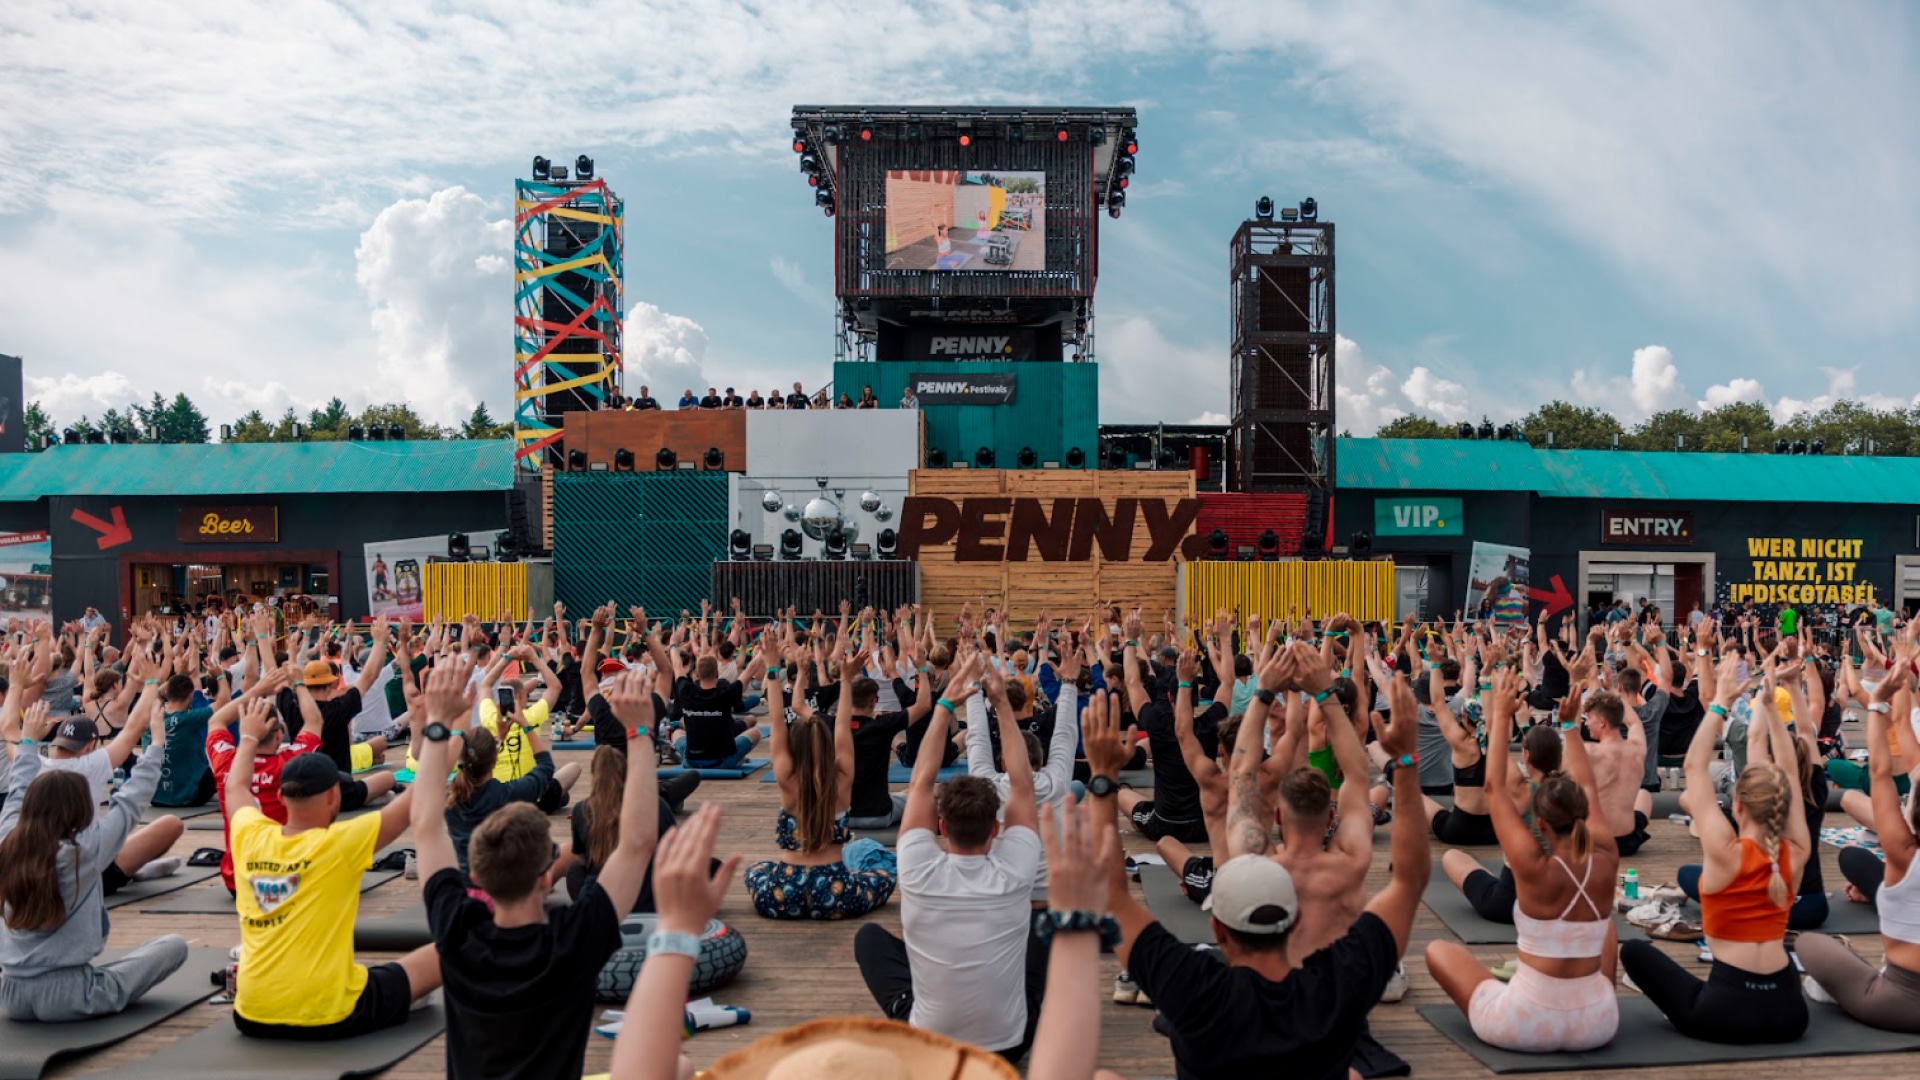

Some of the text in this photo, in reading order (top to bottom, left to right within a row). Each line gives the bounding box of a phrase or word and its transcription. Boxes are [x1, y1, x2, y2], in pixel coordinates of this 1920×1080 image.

[930, 336, 1012, 354] PENNY.
[917, 382, 1007, 394] PENNY. Festivals
[199, 513, 254, 534] Beer
[1394, 505, 1444, 527] VIP.
[898, 497, 1210, 562] PENNY.
[1610, 518, 1687, 536] ENTRY.
[1748, 538, 1863, 559] WER NICHT
[1753, 561, 1856, 584] TANZT, IST
[246, 862, 280, 872] UNITED
